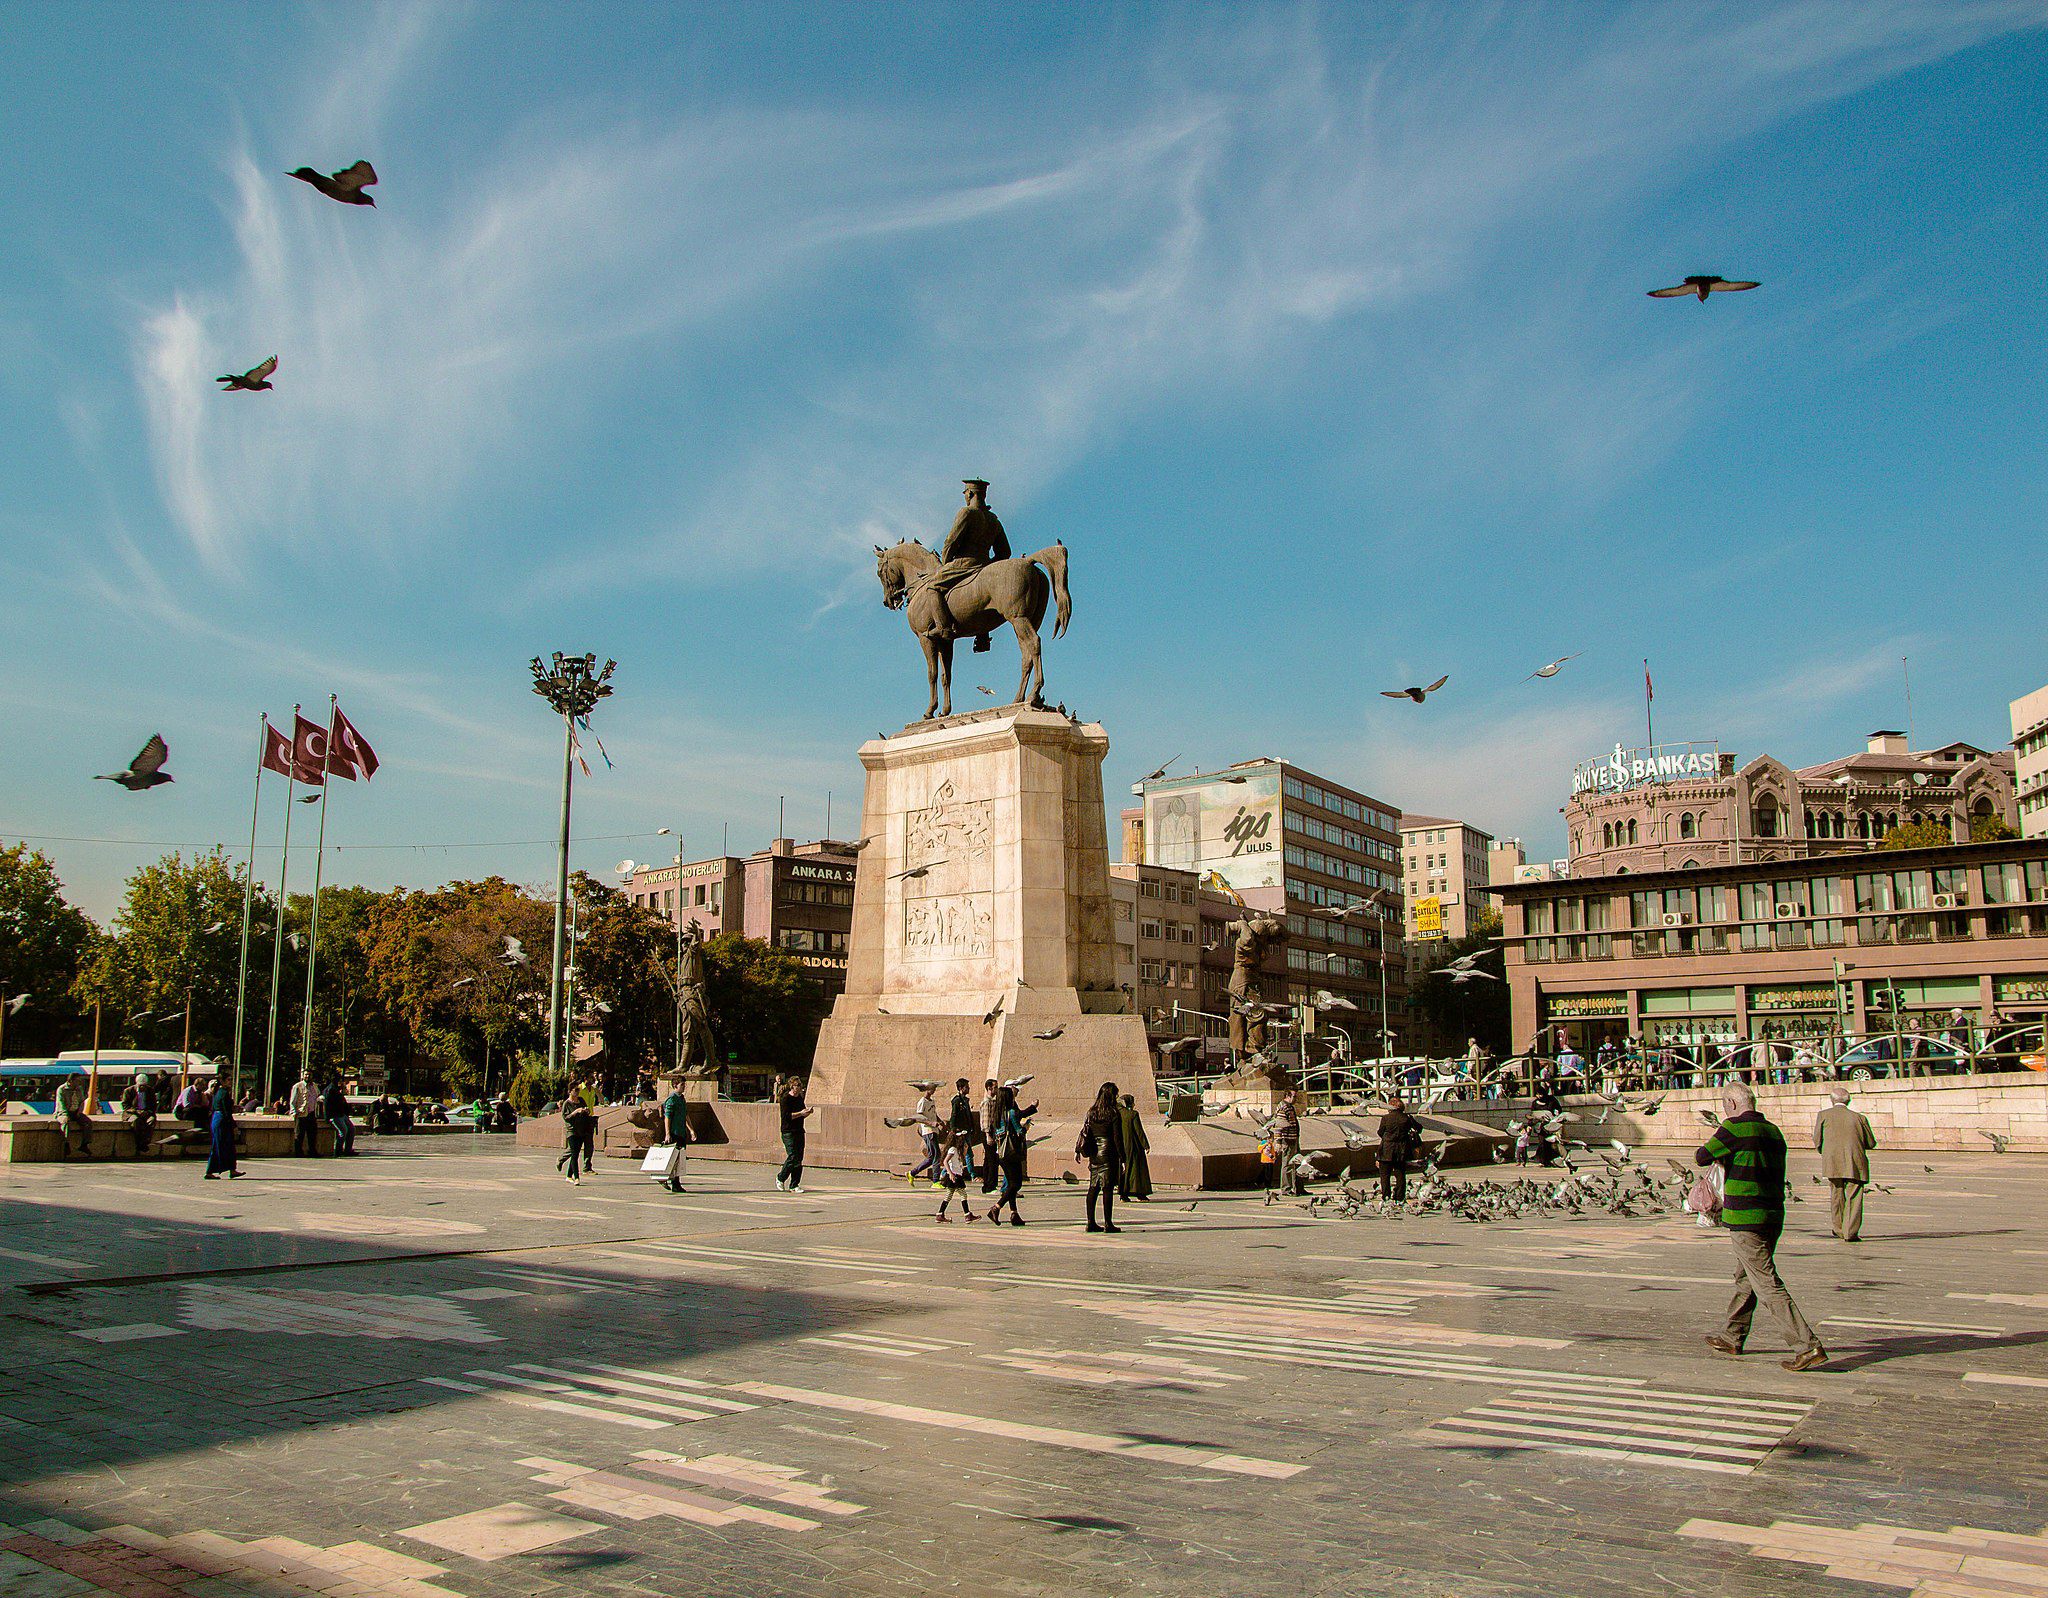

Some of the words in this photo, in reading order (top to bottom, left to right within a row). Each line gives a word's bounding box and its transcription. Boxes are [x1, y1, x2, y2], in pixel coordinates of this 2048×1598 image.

[1632, 752, 1722, 779] BANKASI
[1246, 842, 1272, 853] ULUS
[643, 870, 675, 886] ANKARA
[791, 865, 843, 881] ANKARA
